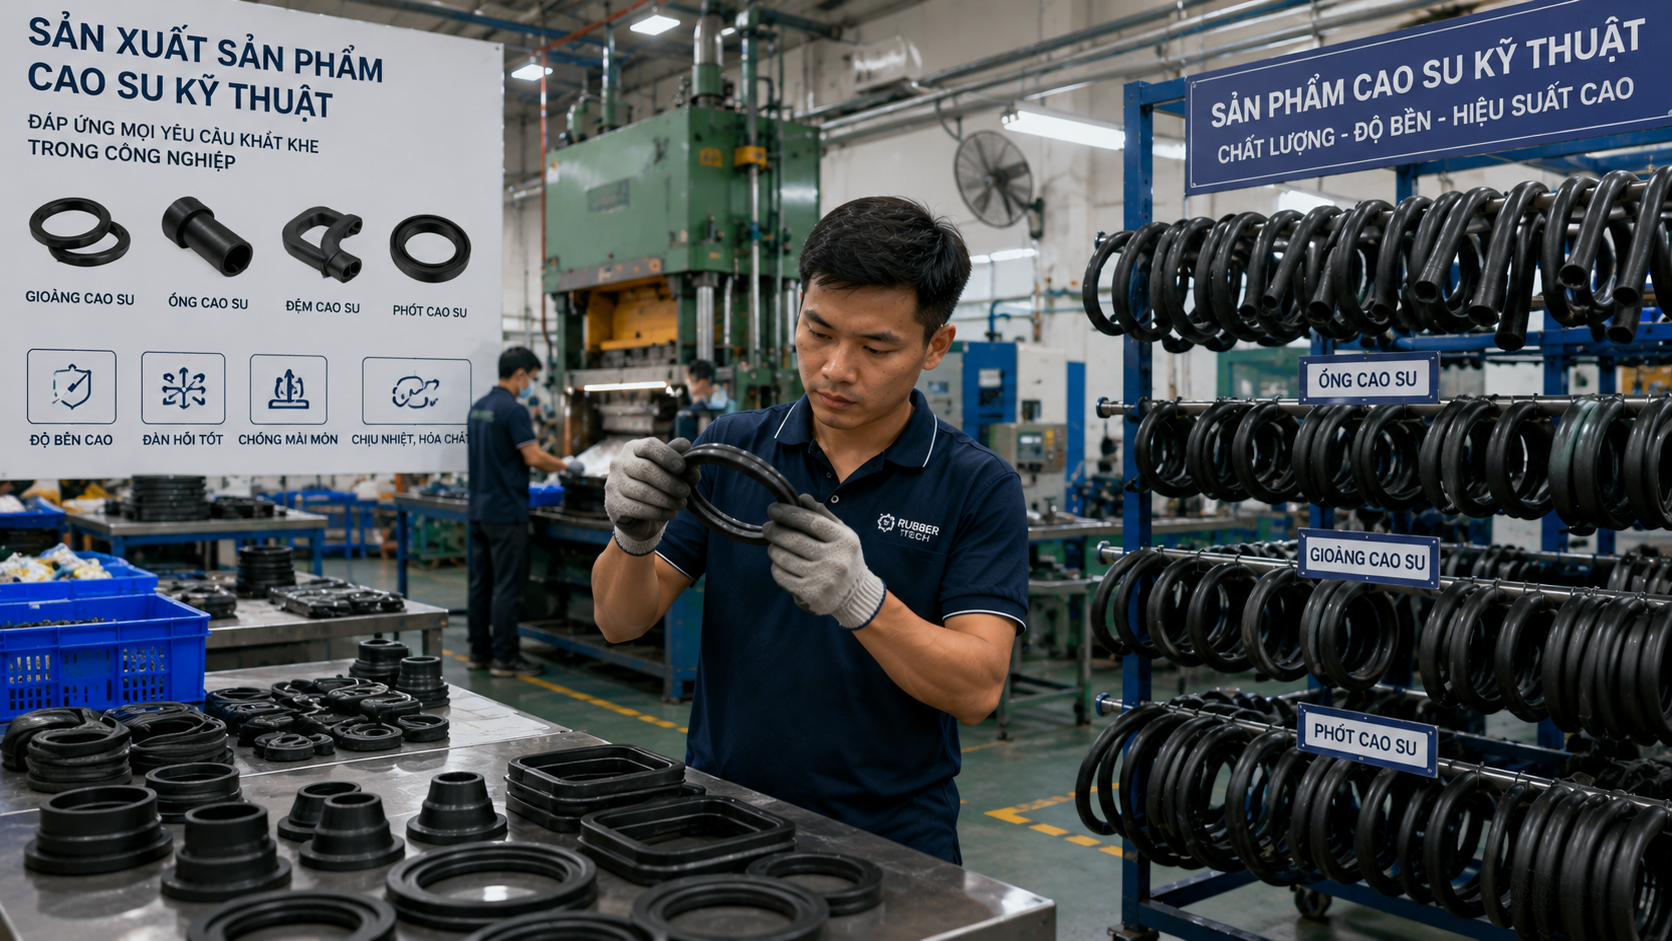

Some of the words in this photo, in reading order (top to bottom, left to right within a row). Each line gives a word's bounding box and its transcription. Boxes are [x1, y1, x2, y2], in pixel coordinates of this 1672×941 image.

[29, 11, 103, 52] SẢN
[117, 25, 207, 62] XUẤT
[218, 34, 283, 72] SẢN
[295, 45, 382, 82] PHẨM
[1212, 92, 1260, 127] SẢN
[1269, 74, 1344, 117] PHẨM
[1354, 66, 1413, 101] CAO
[1423, 55, 1462, 88] SU
[1475, 37, 1517, 79] KỸ
[1526, 16, 1645, 68] THUẬT
[28, 62, 105, 95] CAO
[118, 71, 163, 101] SU
[176, 74, 219, 106] KỸ
[229, 82, 333, 122] THUẬT
[1218, 134, 1264, 163] CHẤT
[1270, 128, 1334, 155] LƯỢNG
[1354, 115, 1383, 143] ĐỘ
[1454, 97, 1503, 126] HIỆU
[1512, 81, 1573, 116] SUẤT
[1581, 77, 1633, 105] CAO
[28, 112, 68, 131] ĐÁP
[75, 115, 114, 135] ỨNG
[121, 122, 154, 141] MỌI
[161, 124, 194, 142] YÊU
[288, 138, 319, 153] KHE
[28, 139, 98, 159] TRONG
[105, 143, 160, 163] CÔNG
[168, 150, 235, 172] NGHIỆP
[26, 289, 80, 303] GIOÀNG
[84, 293, 113, 304] CAO
[117, 294, 134, 305] SU
[201, 297, 228, 308] CAO
[232, 298, 248, 309] SU
[316, 302, 341, 313] CAO
[345, 303, 359, 313] SU
[427, 307, 450, 317] CAO
[453, 308, 467, 318] SU
[1357, 372, 1390, 387] CAO
[1396, 371, 1416, 386] SU
[85, 435, 112, 445] CAO
[143, 432, 169, 445] ĐÀN
[352, 435, 378, 447] CHỊU
[898, 519, 940, 536] RUBBER
[1311, 546, 1365, 565] GIOÀNG
[1369, 552, 1400, 568] CAO
[1405, 554, 1425, 570] SU
[1359, 732, 1390, 751] CAO
[1396, 739, 1416, 756] SU
